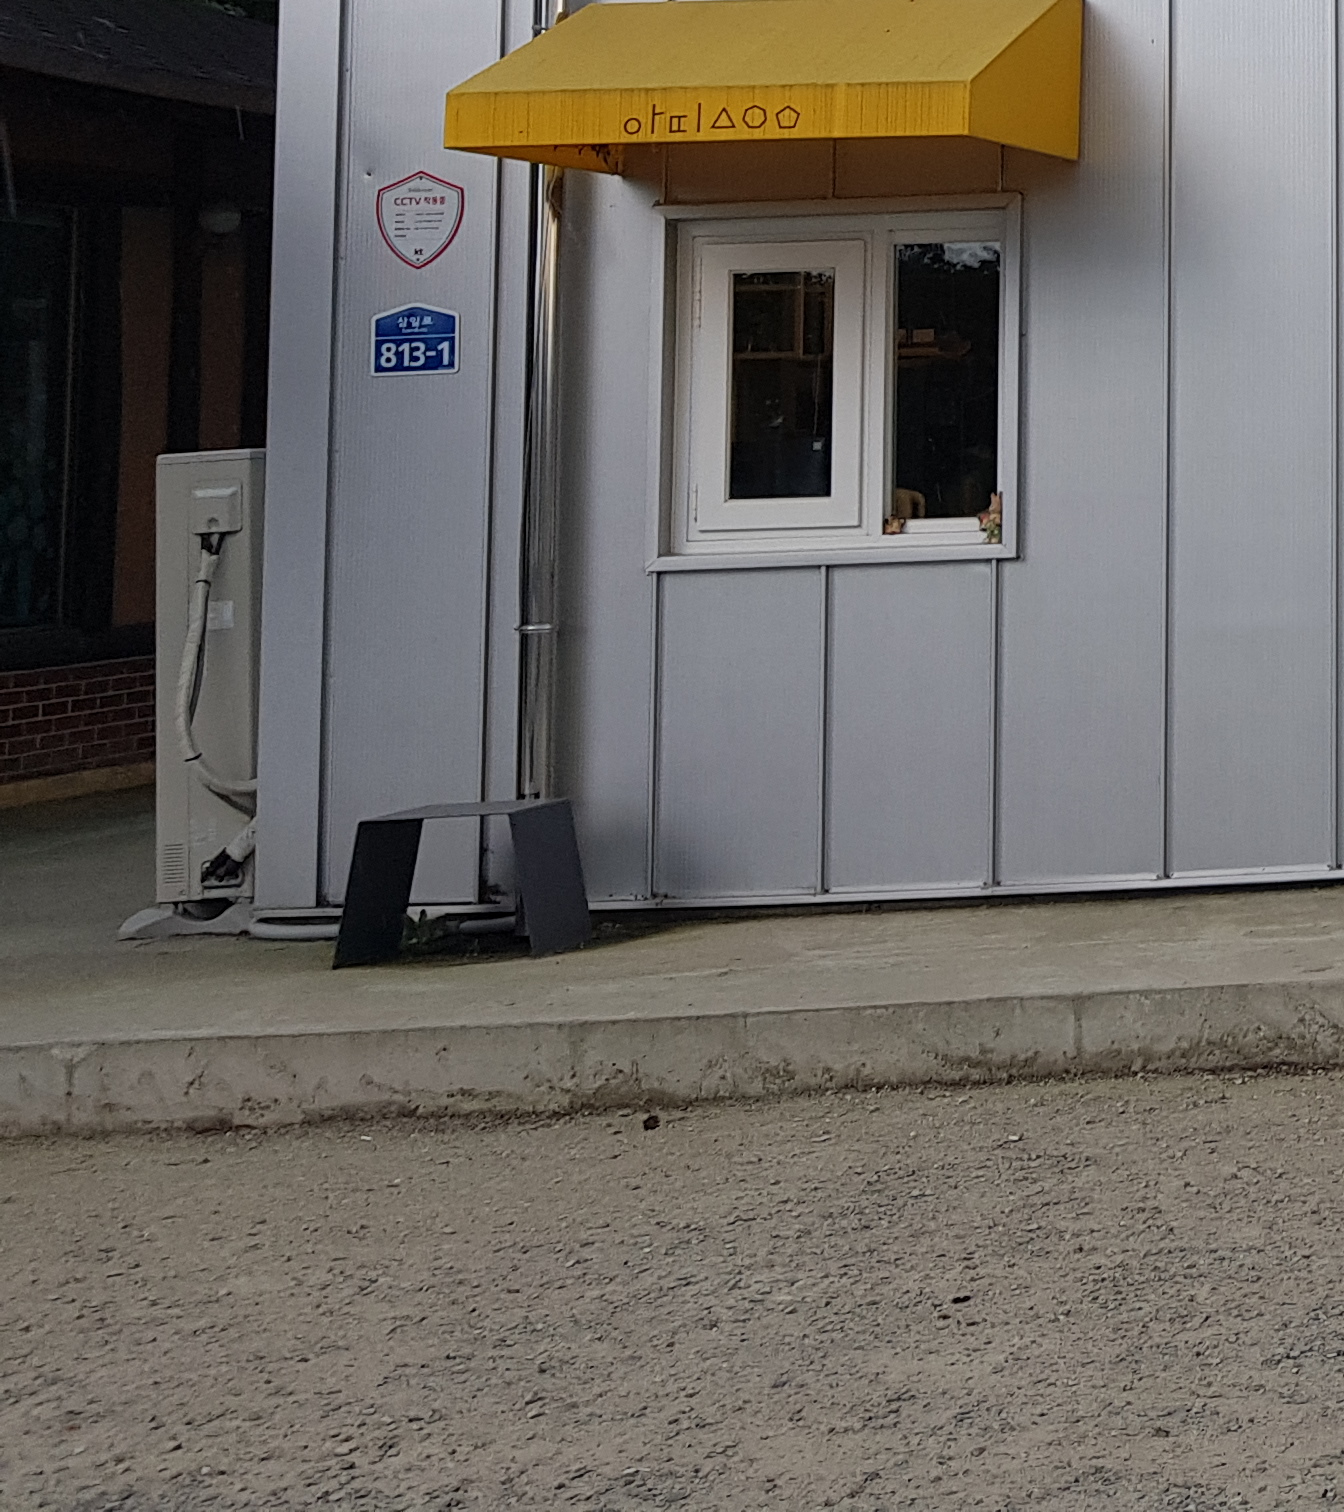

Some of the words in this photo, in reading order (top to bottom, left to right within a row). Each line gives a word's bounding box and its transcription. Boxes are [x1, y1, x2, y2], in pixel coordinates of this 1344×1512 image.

[393, 197, 422, 206] CCTV
[413, 248, 424, 256] kt
[380, 340, 450, 368] 813-1
